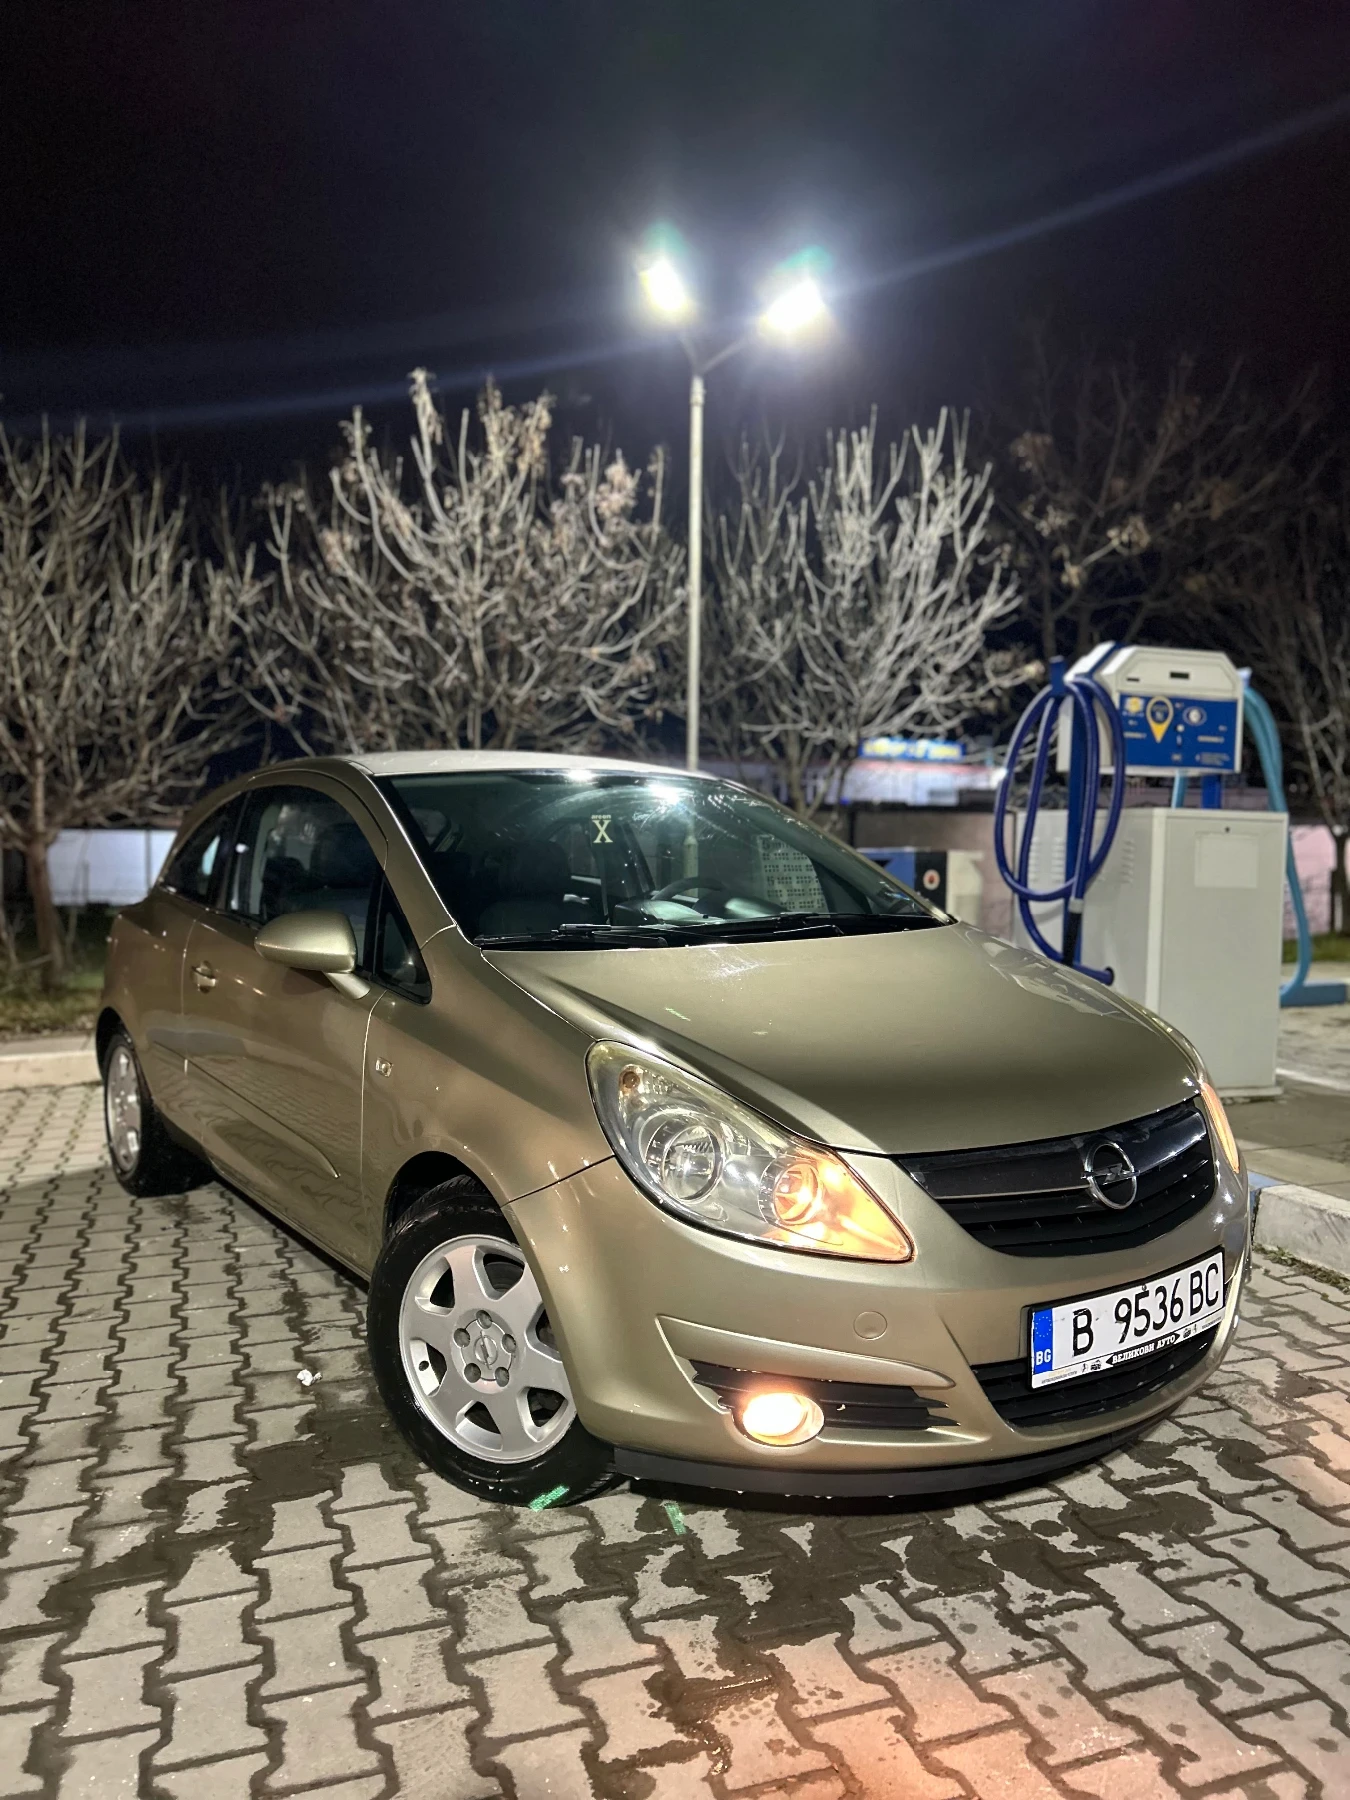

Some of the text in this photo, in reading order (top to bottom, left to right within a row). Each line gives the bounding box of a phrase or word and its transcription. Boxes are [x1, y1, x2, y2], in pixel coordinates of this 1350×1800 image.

[592, 819, 613, 843] X
[1073, 1262, 1219, 1357] B 9536 BC
[1035, 1349, 1052, 1367] BG
